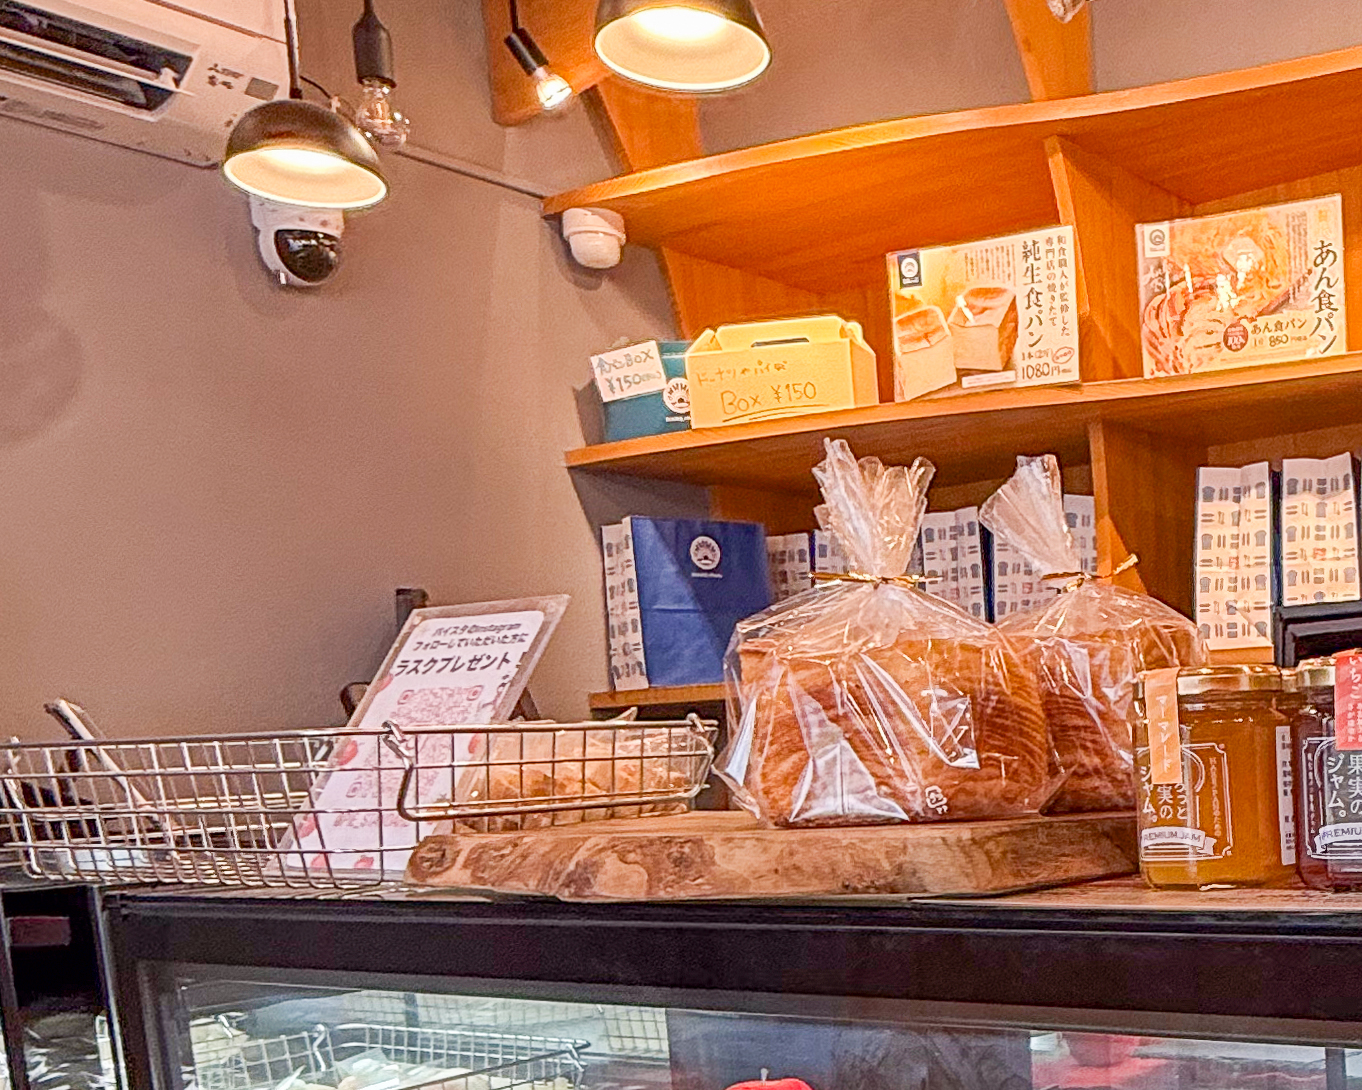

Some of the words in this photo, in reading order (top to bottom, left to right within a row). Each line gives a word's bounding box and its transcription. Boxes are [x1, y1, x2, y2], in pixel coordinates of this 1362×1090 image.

[1021, 239, 1044, 348] 純生食パン
[1308, 240, 1339, 354] あん食パン
[770, 381, 817, 404] ¥150
[395, 652, 512, 677] ラスクプレゼント
[1155, 695, 1173, 775] マーマレード
[1326, 753, 1347, 818] ジャム。
